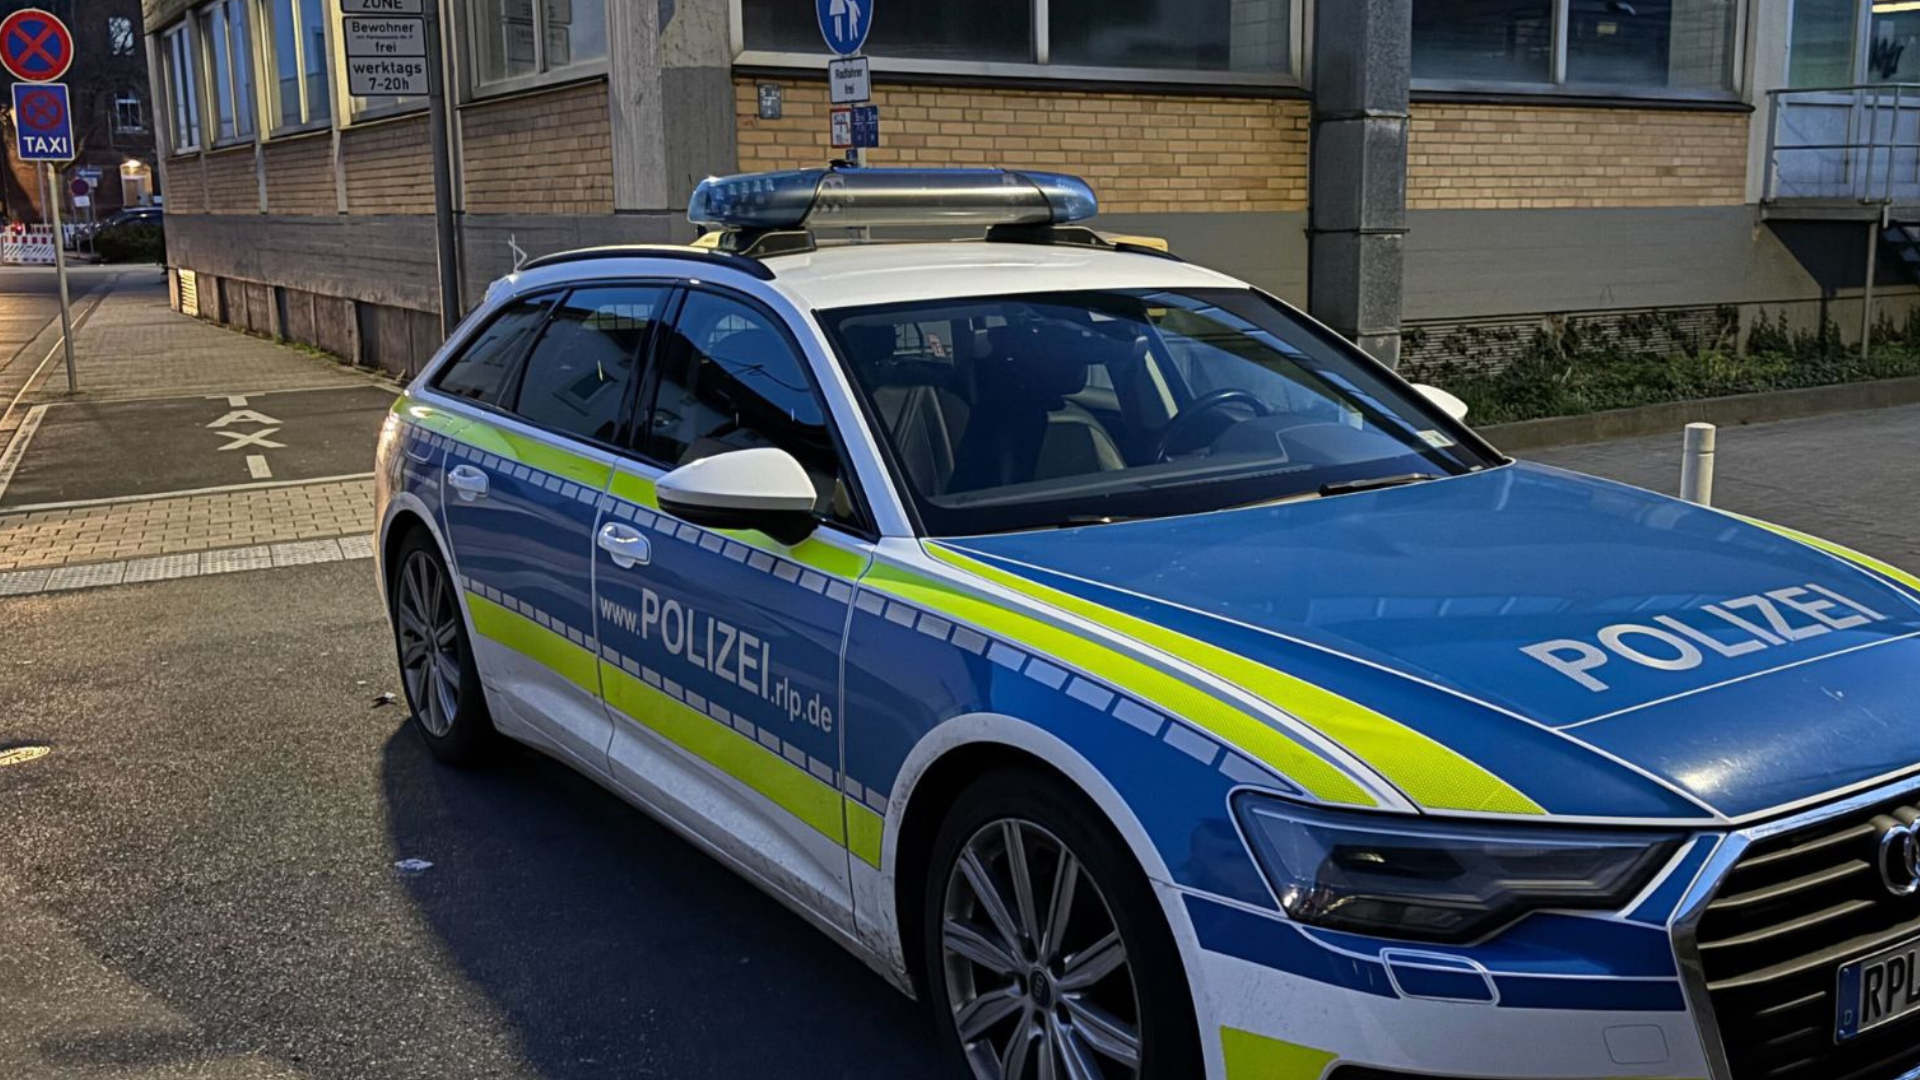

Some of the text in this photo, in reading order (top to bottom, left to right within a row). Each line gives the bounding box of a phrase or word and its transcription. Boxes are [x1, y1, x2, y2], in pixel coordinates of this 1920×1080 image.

[362, 0, 404, 9] ZONE
[352, 21, 414, 33] Bewohner
[375, 41, 397, 53] frei
[353, 61, 423, 77] werktags
[368, 77, 410, 91] 7-20h
[22, 136, 68, 153] TAXI
[1518, 583, 1893, 693] POLIZEI
[599, 587, 833, 733] www.POLIZEI.rlp.de
[1861, 950, 1920, 1024] RPL
